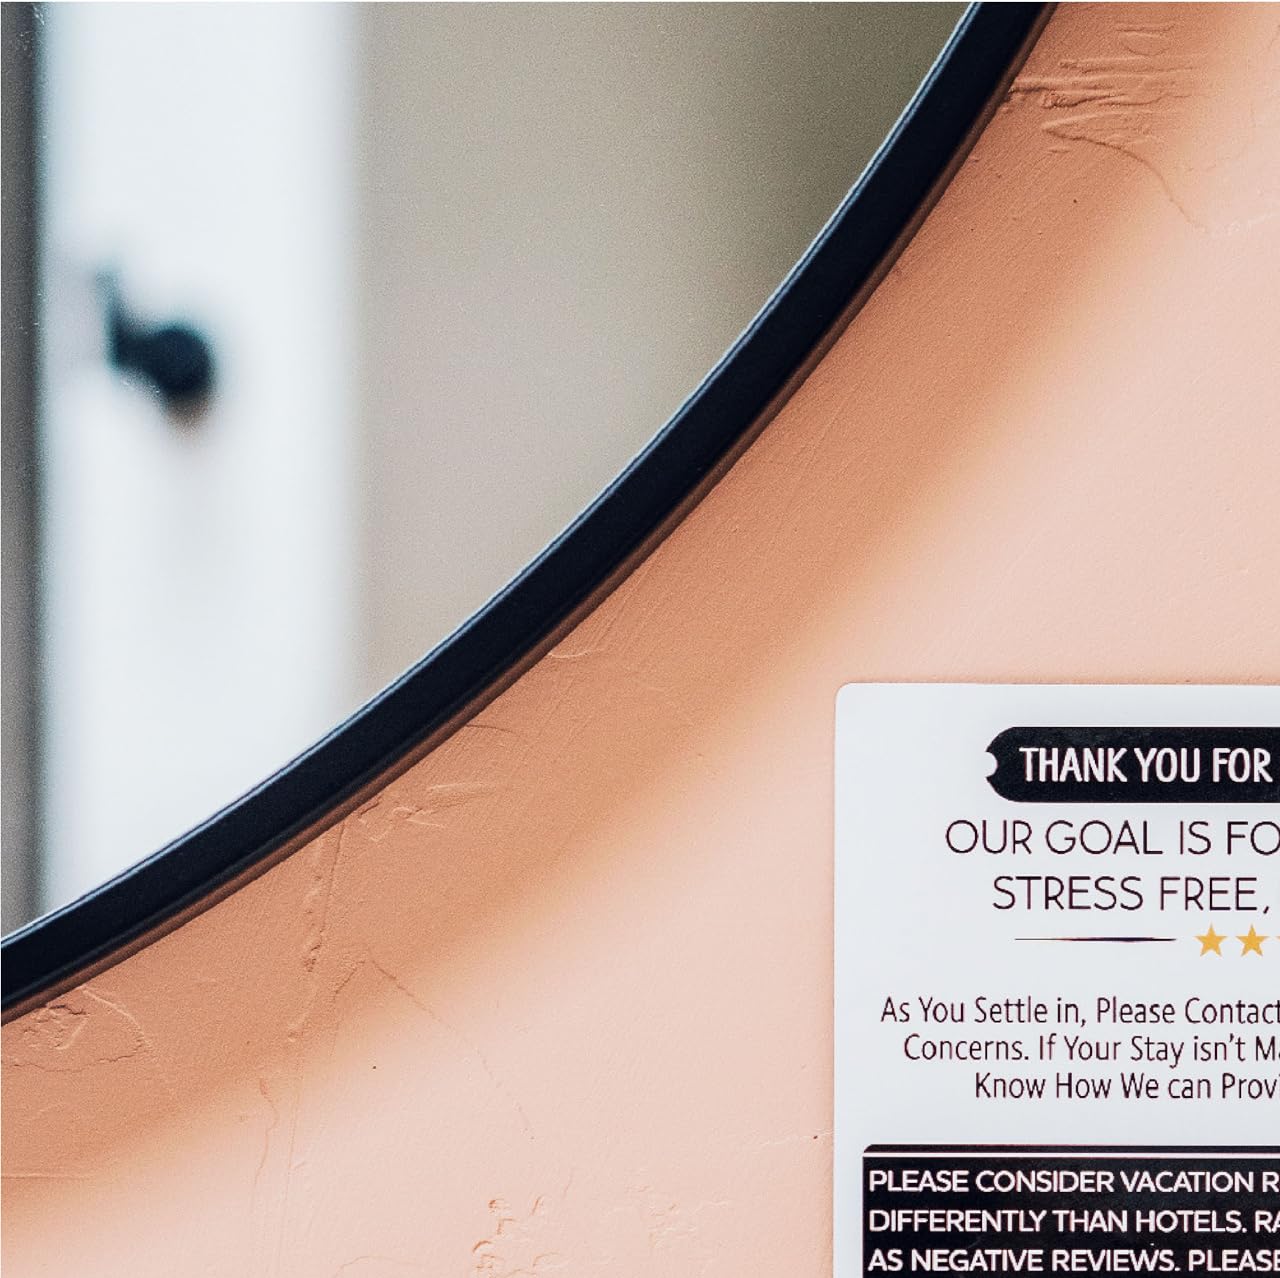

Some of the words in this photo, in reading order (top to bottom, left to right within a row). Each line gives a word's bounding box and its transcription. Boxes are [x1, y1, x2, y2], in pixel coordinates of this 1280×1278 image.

[1018, 746, 1128, 783] THANK
[1133, 747, 1201, 783] YOU
[1212, 747, 1273, 783] FOR
[944, 819, 1033, 855] OUR
[1044, 819, 1164, 855] GOAL
[1179, 820, 1212, 856] IS
[992, 875, 1144, 911] STRESS
[1159, 875, 1270, 915] FREE,
[880, 996, 910, 1023] As
[918, 996, 965, 1024] You
[974, 995, 1048, 1024] Settle
[1056, 996, 1087, 1028] in,
[1096, 995, 1176, 1024] Please
[903, 1032, 1029, 1061] Concerns.
[1039, 1032, 1058, 1061] If
[1063, 1035, 1122, 1061] Your
[1129, 1035, 1185, 1070] Stay
[1193, 1032, 1246, 1063] isn't
[975, 1071, 1047, 1099] Know
[1055, 1072, 1112, 1099] How
[1120, 1072, 1159, 1099] We
[1167, 1078, 1212, 1099] can
[869, 1169, 970, 1193] PLEASE
[975, 1169, 1115, 1193] CONSIDER
[1119, 1170, 1254, 1193] VACATION
[869, 1209, 1048, 1232] DIFFERENTLY
[1051, 1209, 1128, 1233] THAN
[1135, 1209, 1248, 1234] HOTELS.
[867, 1248, 904, 1272] AS
[911, 1248, 1044, 1272] NEGATIVE
[1051, 1249, 1181, 1272] REVIEWS.
